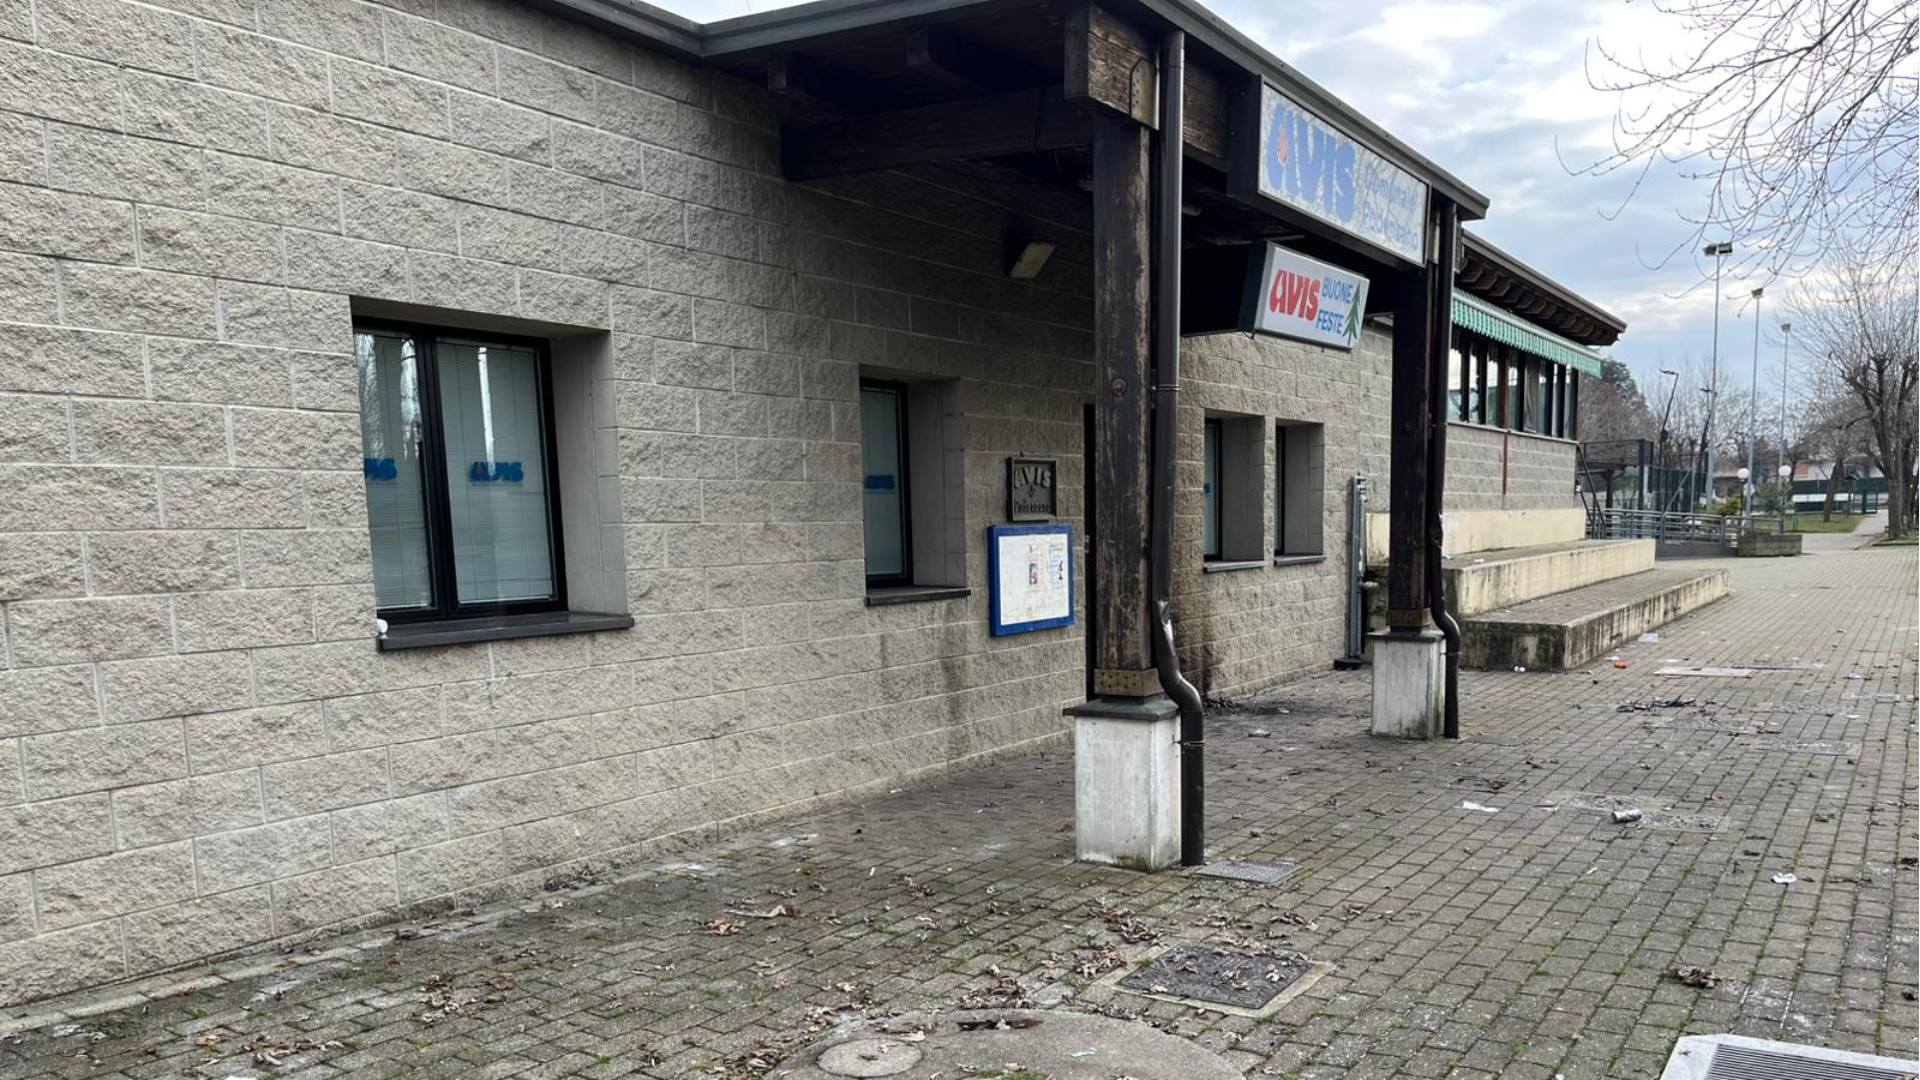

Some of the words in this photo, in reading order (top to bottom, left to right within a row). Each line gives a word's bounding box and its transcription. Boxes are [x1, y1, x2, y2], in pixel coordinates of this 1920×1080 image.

[1266, 102, 1357, 223] AVIS
[1269, 268, 1321, 322] AVIS
[1322, 275, 1354, 303] BUONE
[1315, 308, 1345, 336] FESTE
[1014, 465, 1051, 489] AVIS
